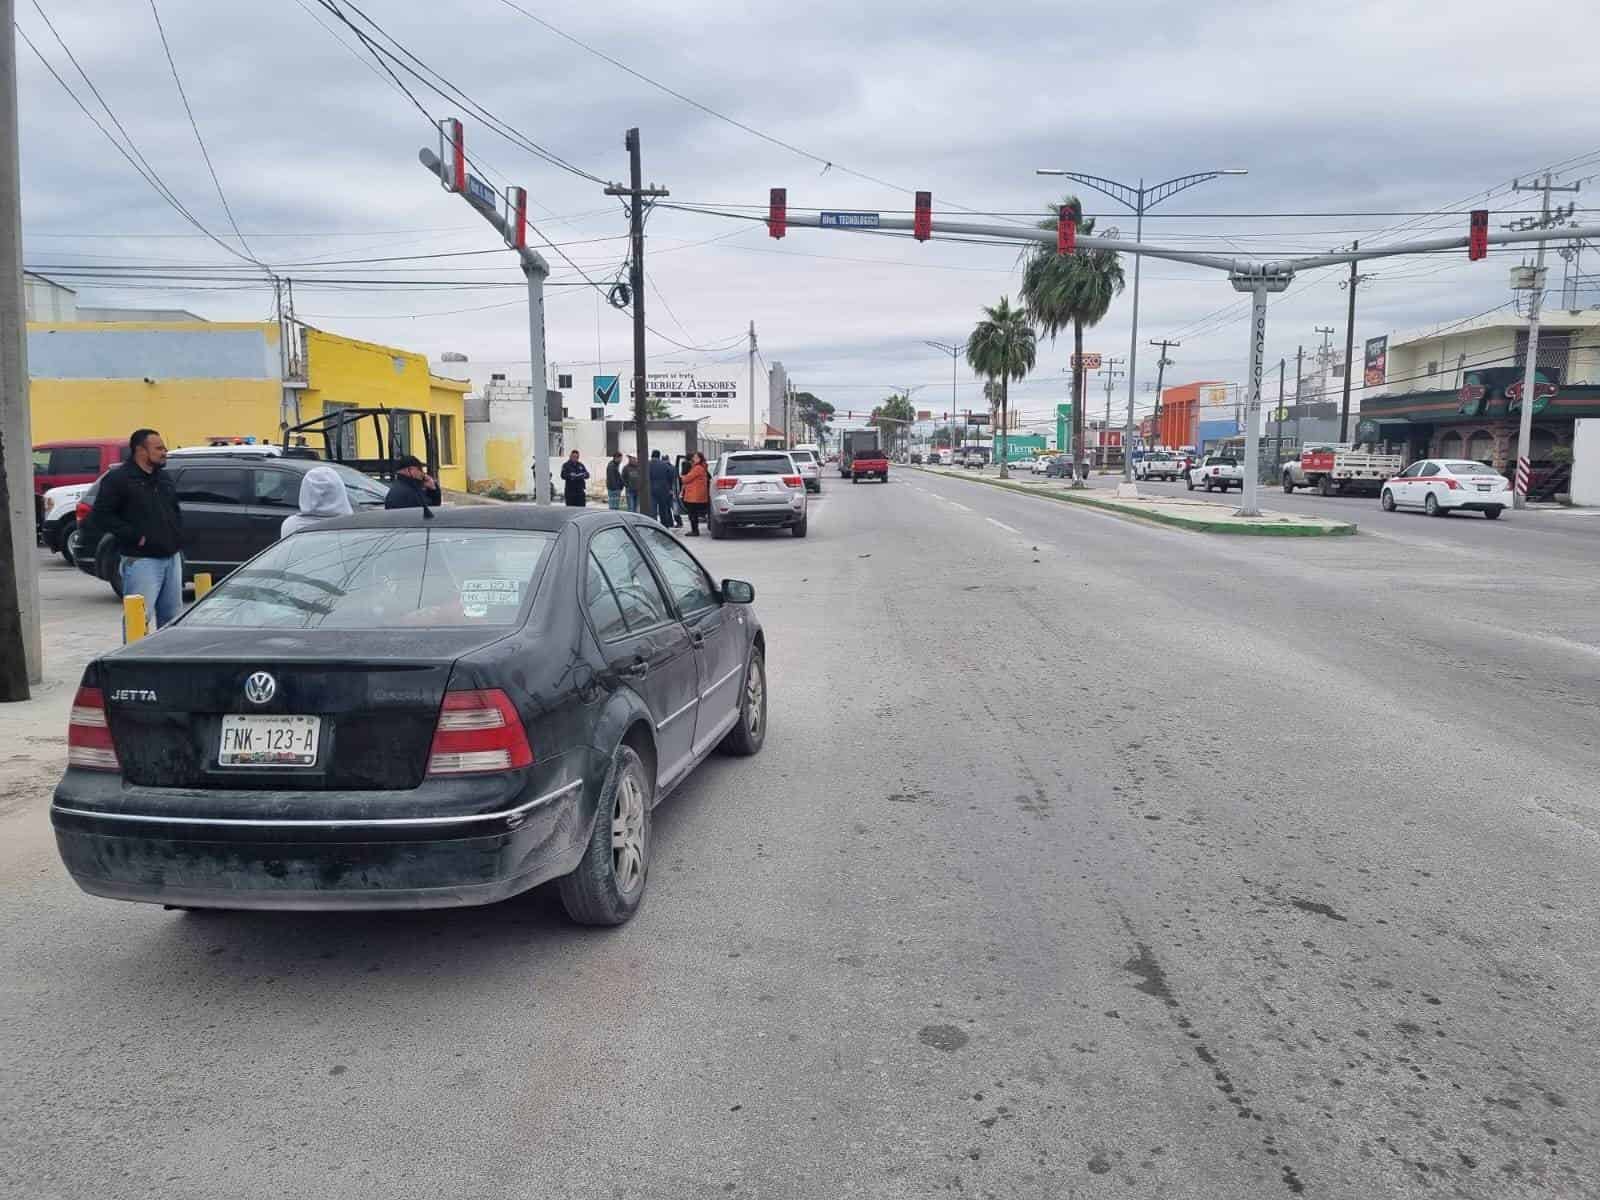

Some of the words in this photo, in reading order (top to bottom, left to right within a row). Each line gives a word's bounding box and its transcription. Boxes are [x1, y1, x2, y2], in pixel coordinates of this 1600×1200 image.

[688, 379, 736, 390] ASESORES
[111, 689, 157, 701] JETTA
[223, 727, 313, 751] FNK-123-A
